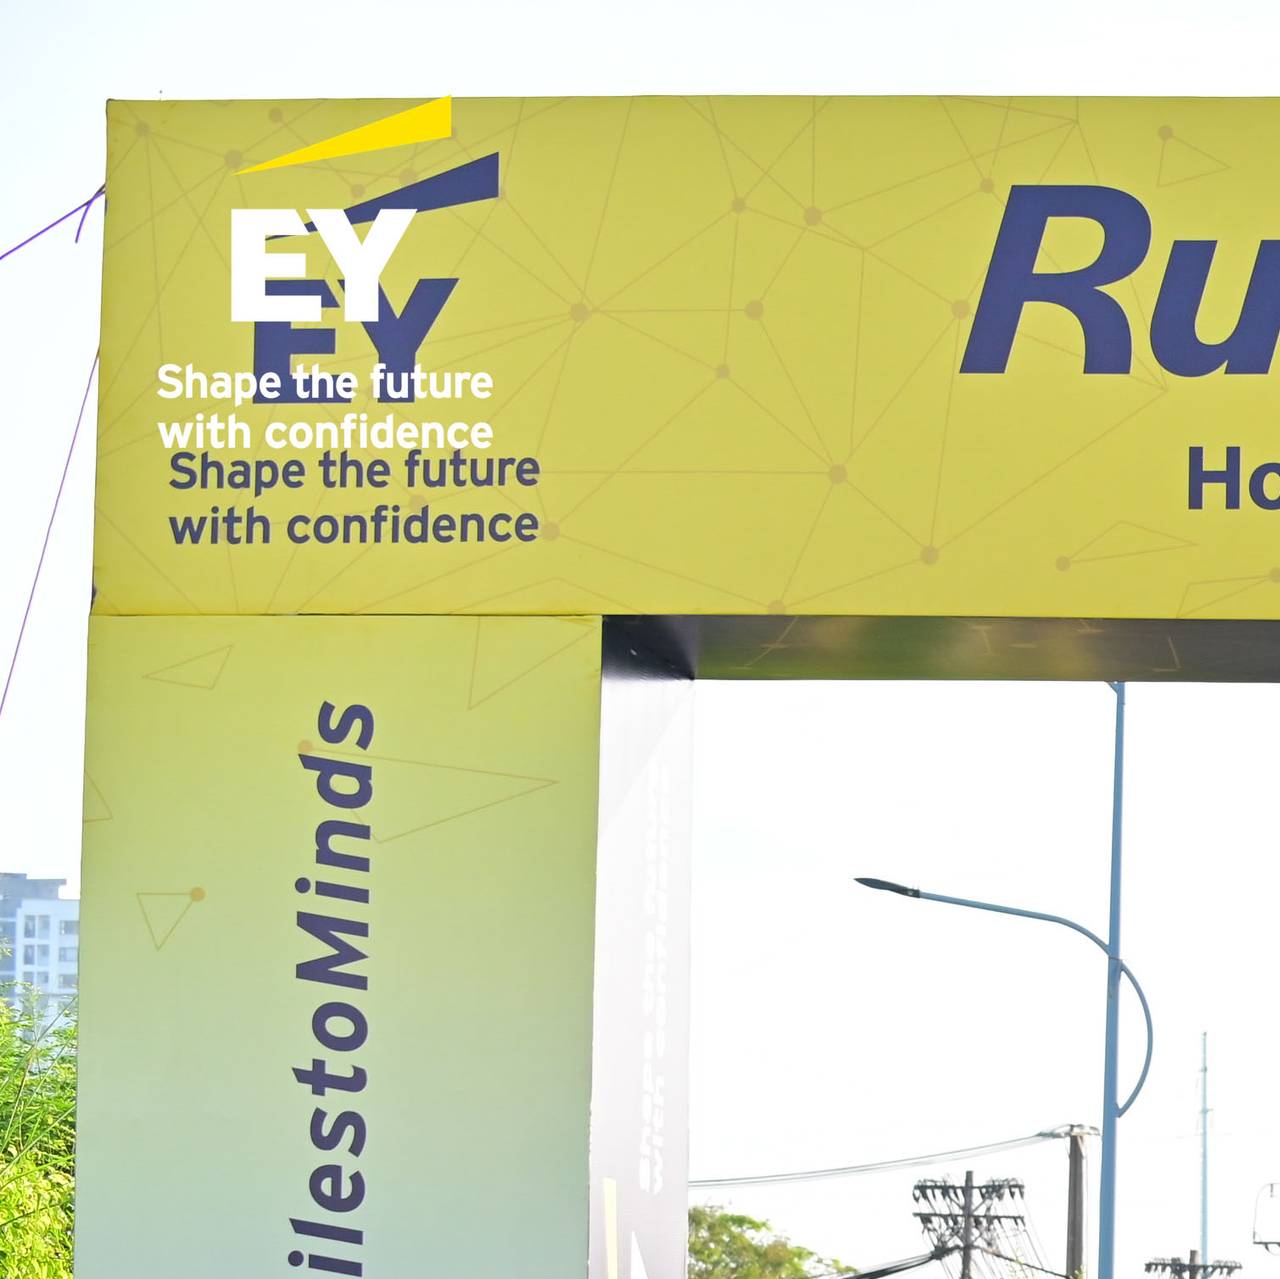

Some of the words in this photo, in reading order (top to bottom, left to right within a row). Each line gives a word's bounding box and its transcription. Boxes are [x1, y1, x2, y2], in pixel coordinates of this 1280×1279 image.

[253, 277, 459, 404] EY
[170, 451, 305, 496] Shape
[319, 451, 390, 488] the
[405, 450, 540, 488] future
[170, 507, 271, 545] with
[288, 505, 539, 545] confidence
